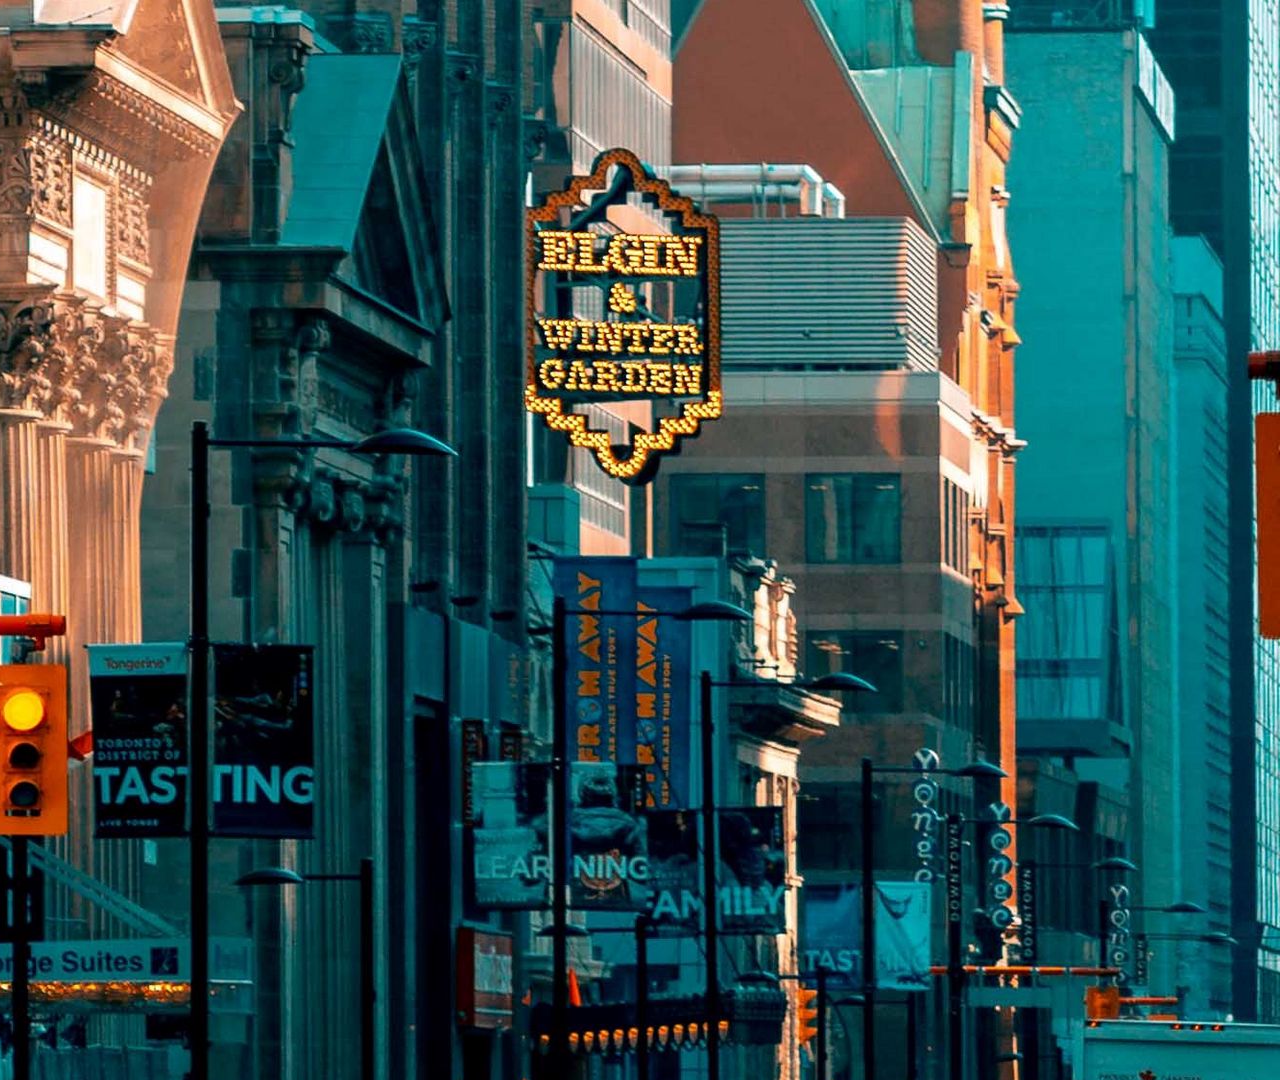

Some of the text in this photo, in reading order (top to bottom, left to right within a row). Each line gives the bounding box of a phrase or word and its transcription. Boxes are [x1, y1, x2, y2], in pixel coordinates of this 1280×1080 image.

[538, 231, 704, 276] ELGIN
[608, 282, 637, 314] &
[538, 318, 704, 355] WINTER
[539, 358, 703, 395] GARDEN
[577, 571, 601, 663] AWAY
[104, 656, 164, 670] Tangerine
[636, 601, 658, 688] AWAY
[97, 751, 181, 761] DISTRICT OF
[61, 950, 144, 973] Suites
